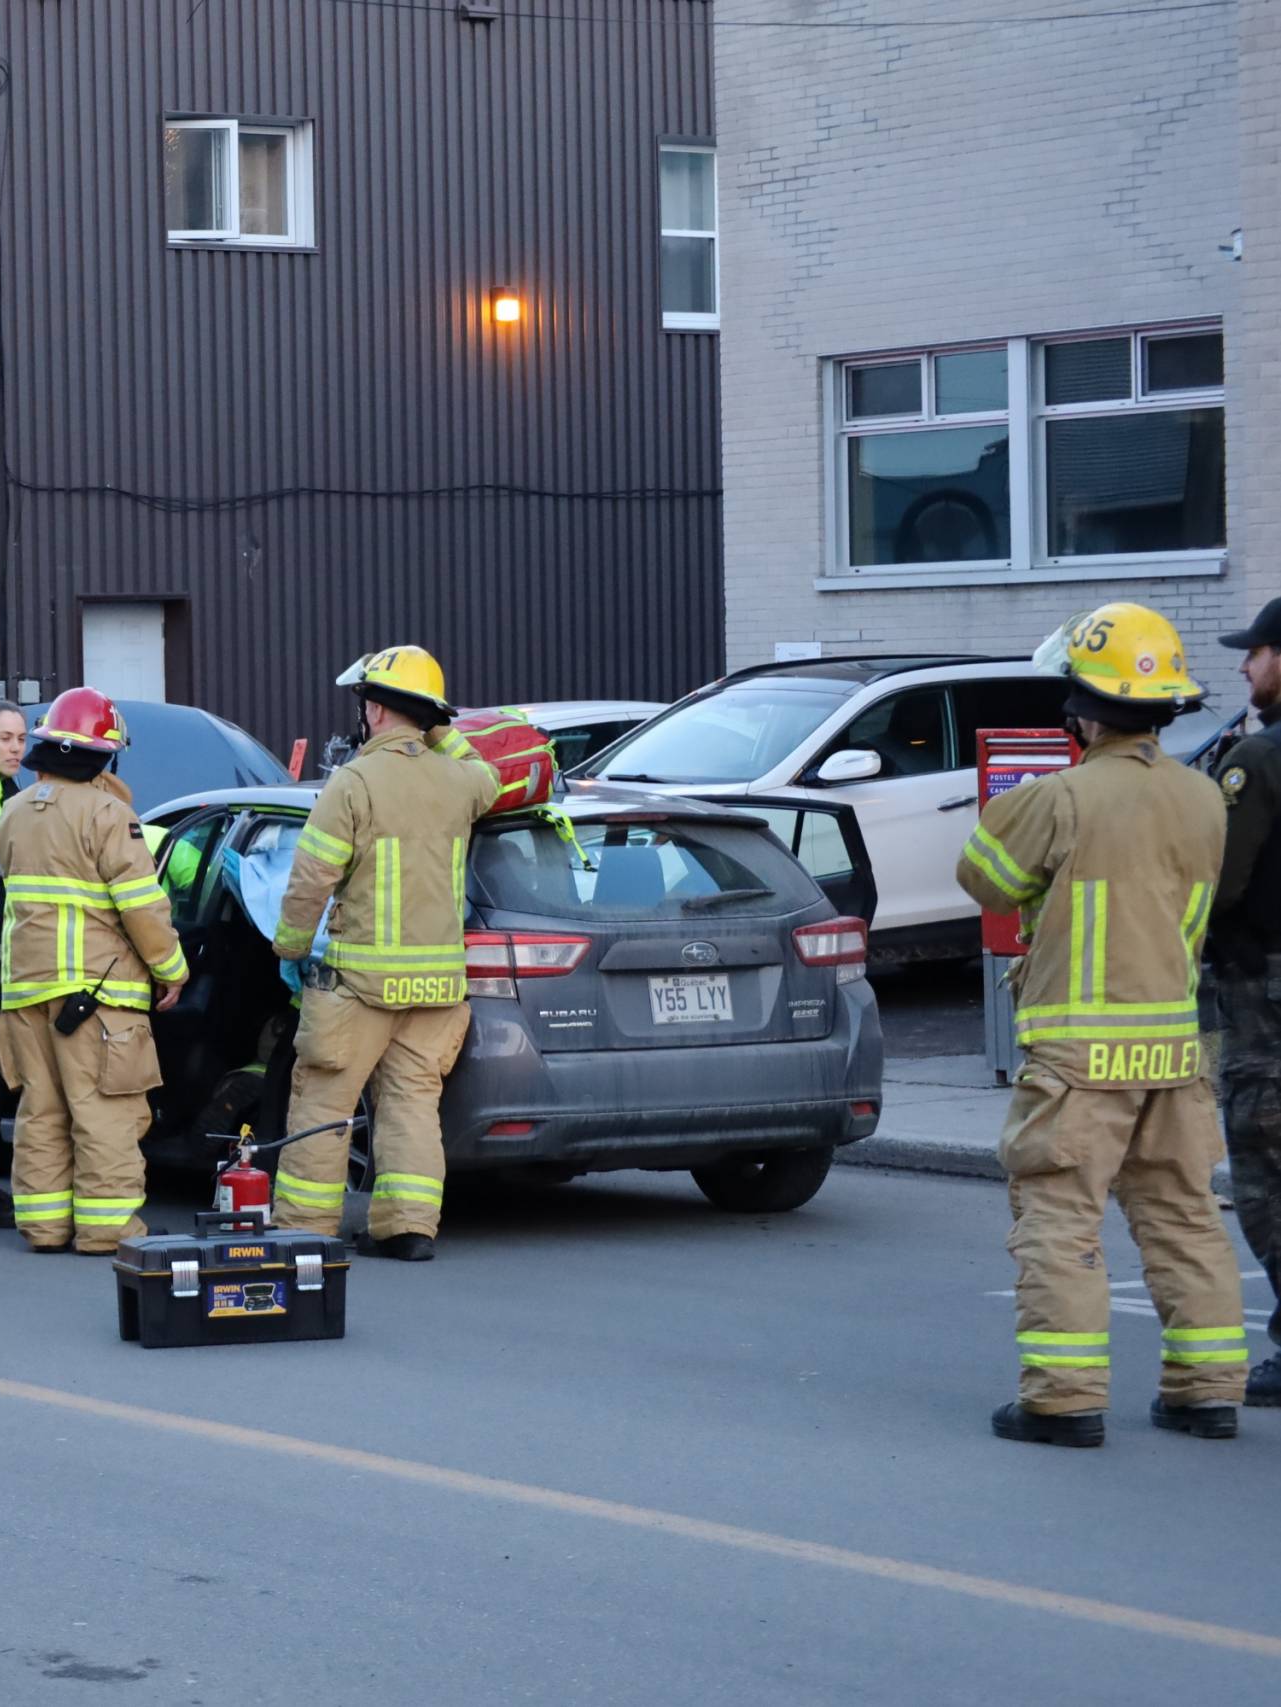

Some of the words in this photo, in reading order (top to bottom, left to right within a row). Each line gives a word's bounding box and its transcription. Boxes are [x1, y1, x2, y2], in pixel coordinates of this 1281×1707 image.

[369, 651, 399, 671] 21
[654, 987, 688, 1012] Y55
[696, 985, 726, 1010] LYY
[539, 1009, 597, 1017] SUBARU
[228, 1246, 265, 1258] IRWIN
[213, 1284, 241, 1294] IRWIN
